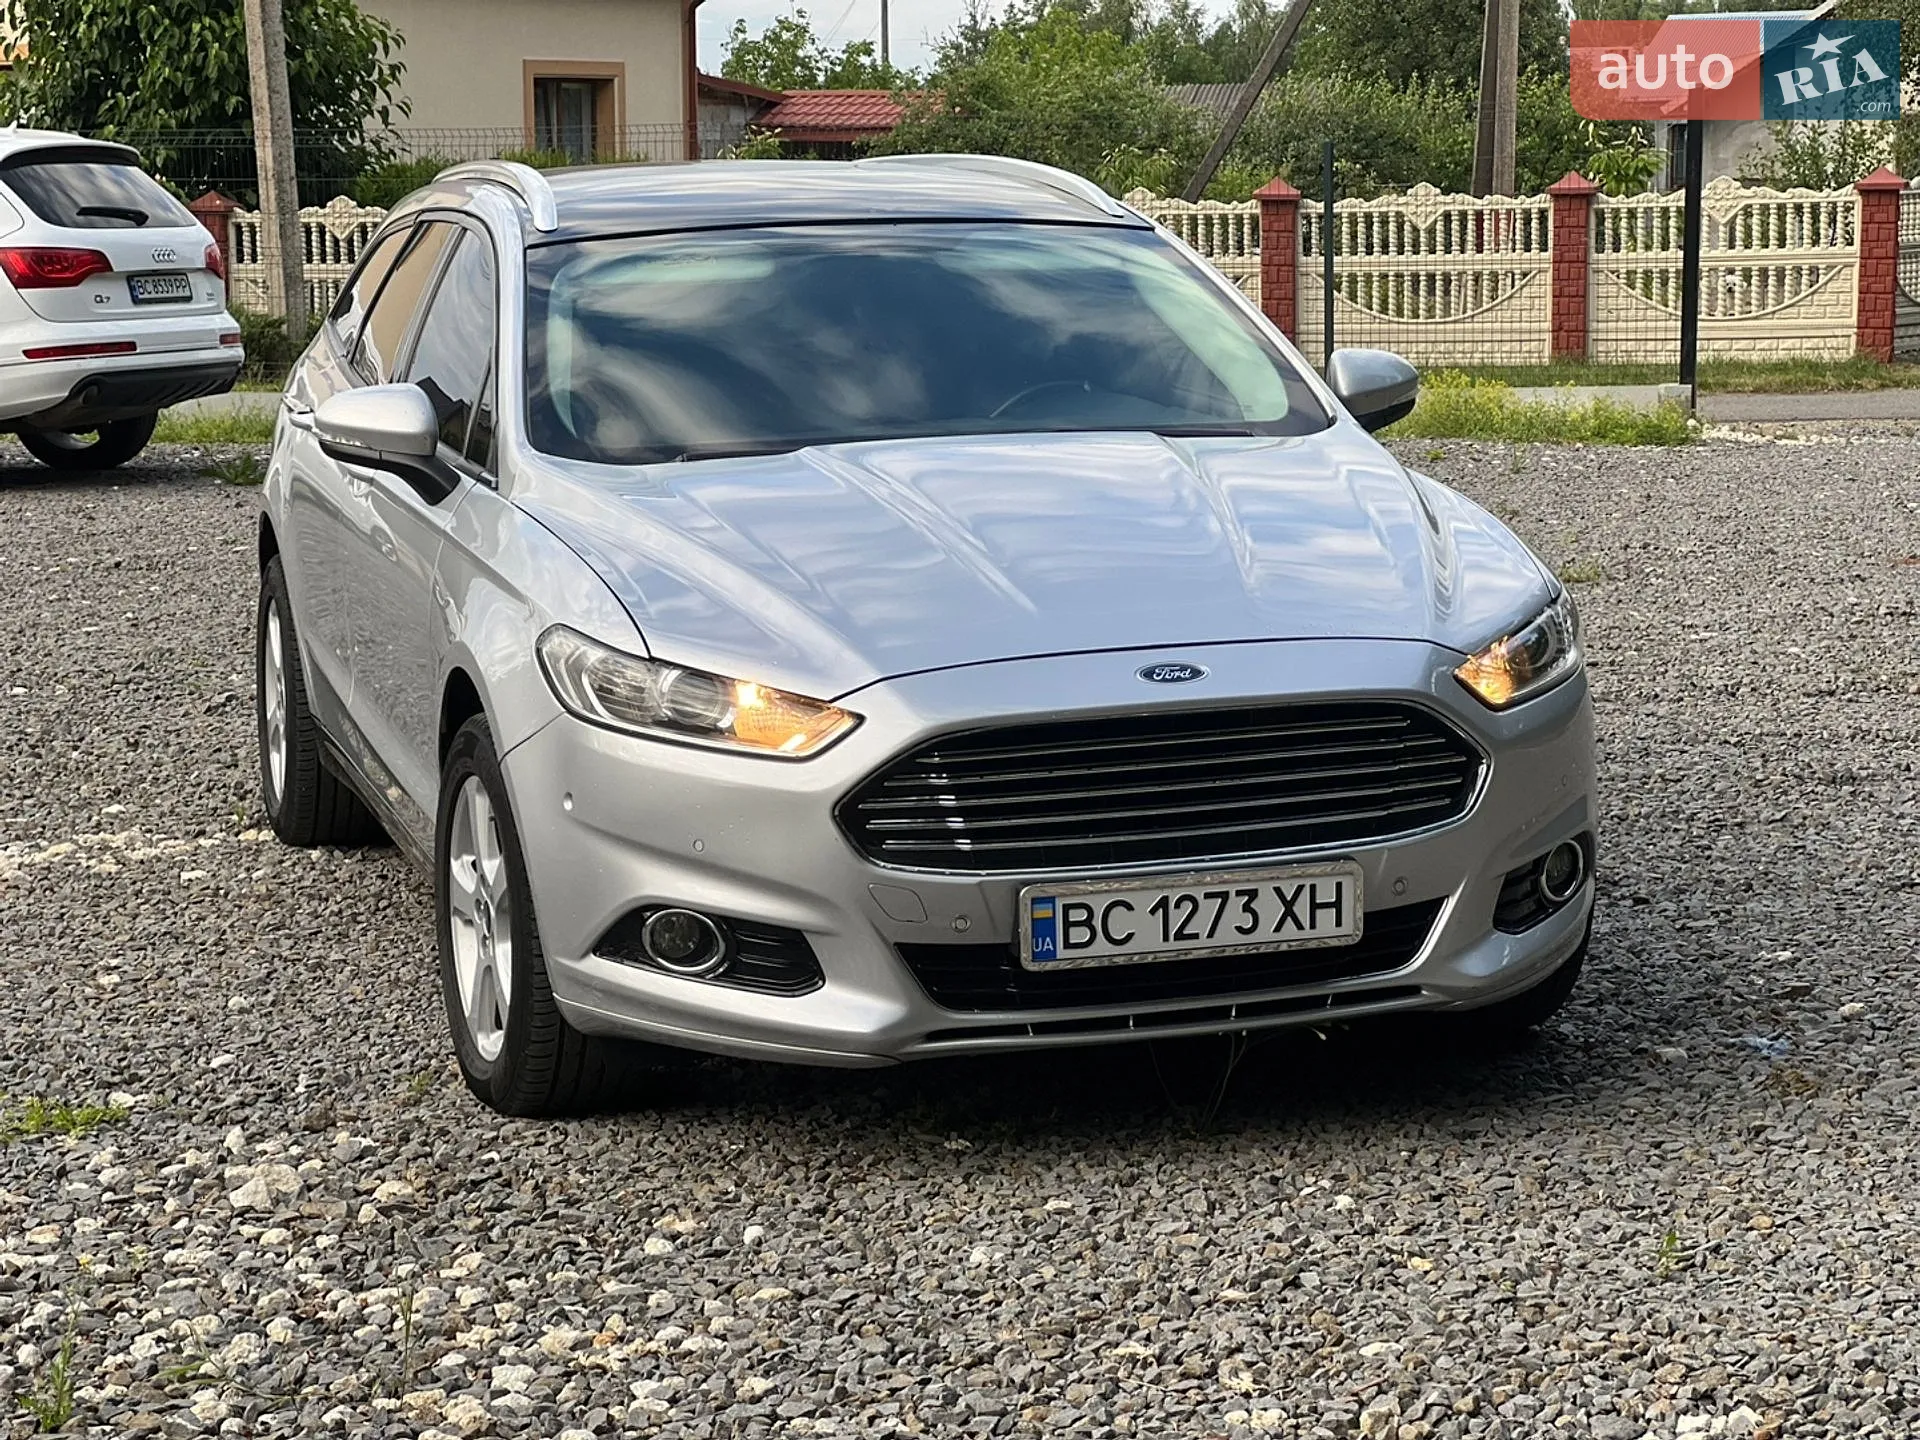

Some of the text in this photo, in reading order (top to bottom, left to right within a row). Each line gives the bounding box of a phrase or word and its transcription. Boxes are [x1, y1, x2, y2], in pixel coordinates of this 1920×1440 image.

[137, 277, 188, 295] BC 8539 PP
[94, 294, 111, 304] Q7
[1153, 666, 1192, 680] Ford
[1061, 881, 1344, 950] BC 1273 XH
[1033, 936, 1054, 952] UA
